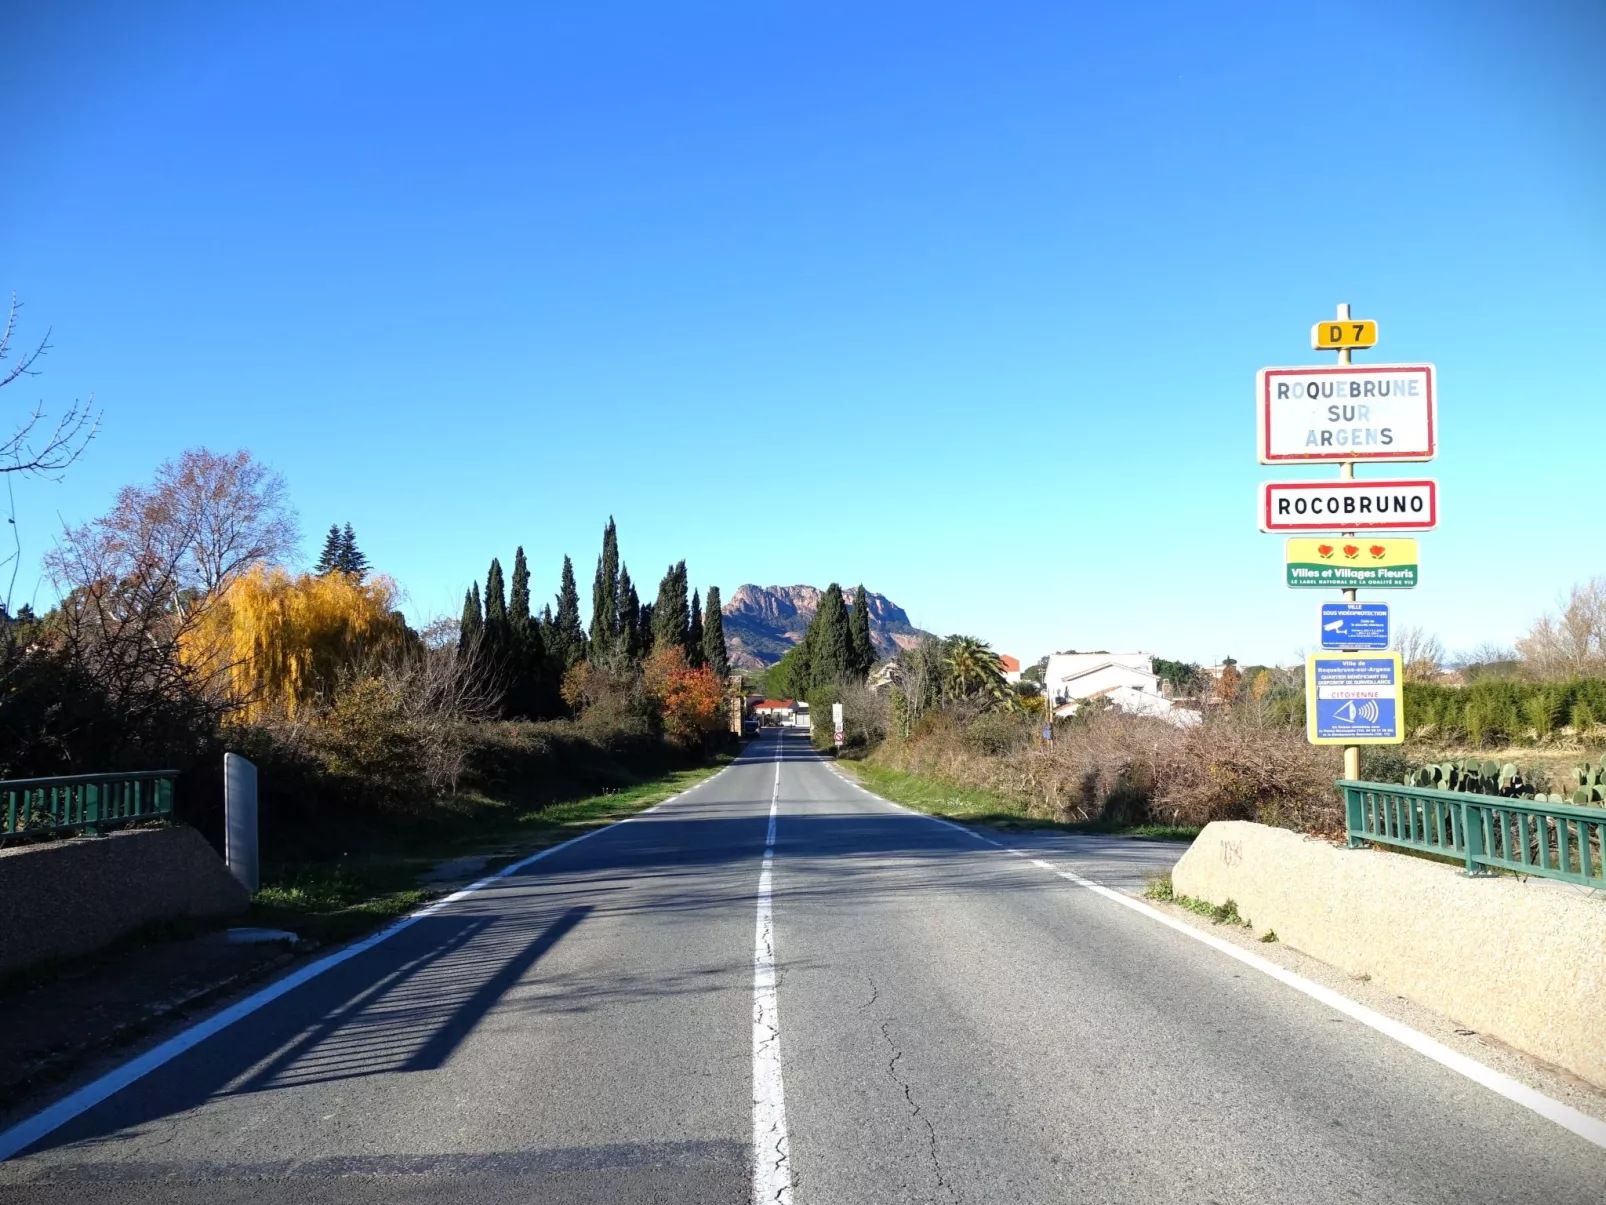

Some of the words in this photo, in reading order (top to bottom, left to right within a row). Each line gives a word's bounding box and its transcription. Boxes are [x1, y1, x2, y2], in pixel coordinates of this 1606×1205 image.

[1330, 326, 1342, 342] D
[1352, 325, 1364, 341] 7
[1277, 380, 1419, 400] ROQUEBRUNE
[1328, 404, 1370, 422] SUR
[1306, 428, 1393, 446] ARGENS
[1278, 496, 1423, 514] ROCOBRUNO
[1292, 568, 1319, 578] Villes
[1322, 568, 1332, 578] et
[1334, 568, 1375, 580] Villages
[1378, 569, 1413, 578] Fleuris
